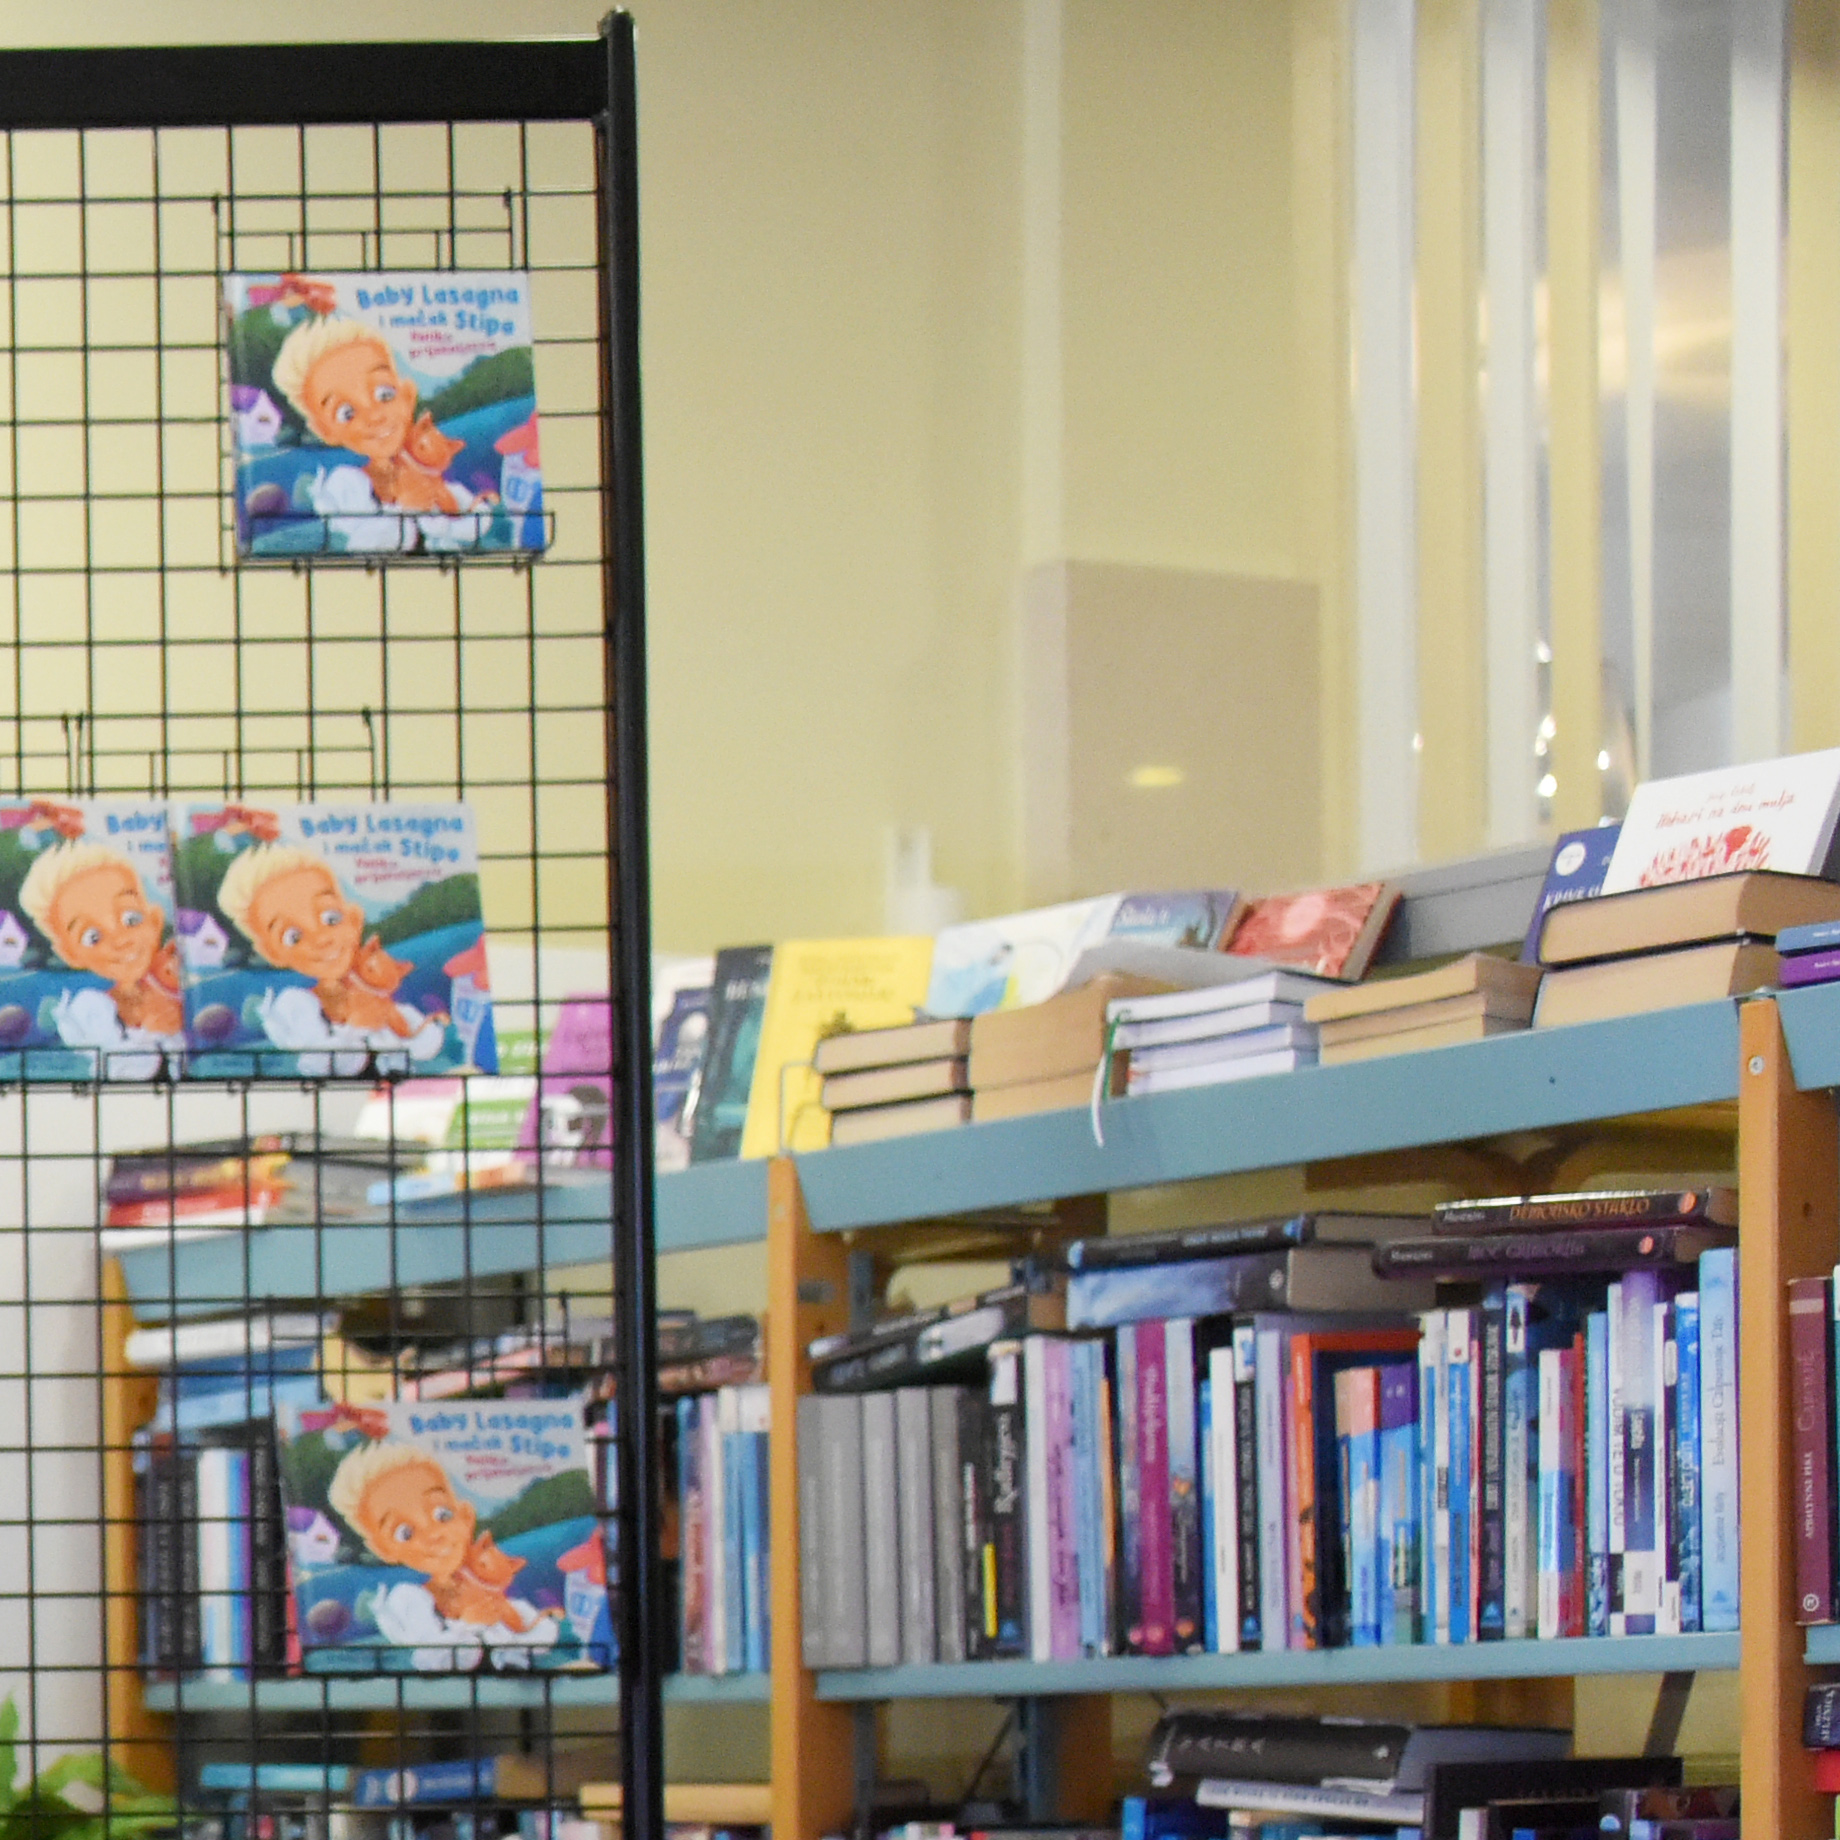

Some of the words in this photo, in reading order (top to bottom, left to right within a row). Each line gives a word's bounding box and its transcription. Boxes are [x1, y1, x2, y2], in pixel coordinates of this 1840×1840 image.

[357, 285, 413, 310] Baby
[422, 284, 519, 311] Lasagna
[455, 310, 514, 337] Stipe
[107, 811, 166, 835] Baby
[300, 813, 357, 838] Baby
[366, 813, 463, 838] Lasagna
[400, 838, 460, 862] Stipe
[410, 1412, 467, 1434] Baby
[475, 1412, 573, 1435] Lasagna
[512, 1434, 570, 1459] Stipe
